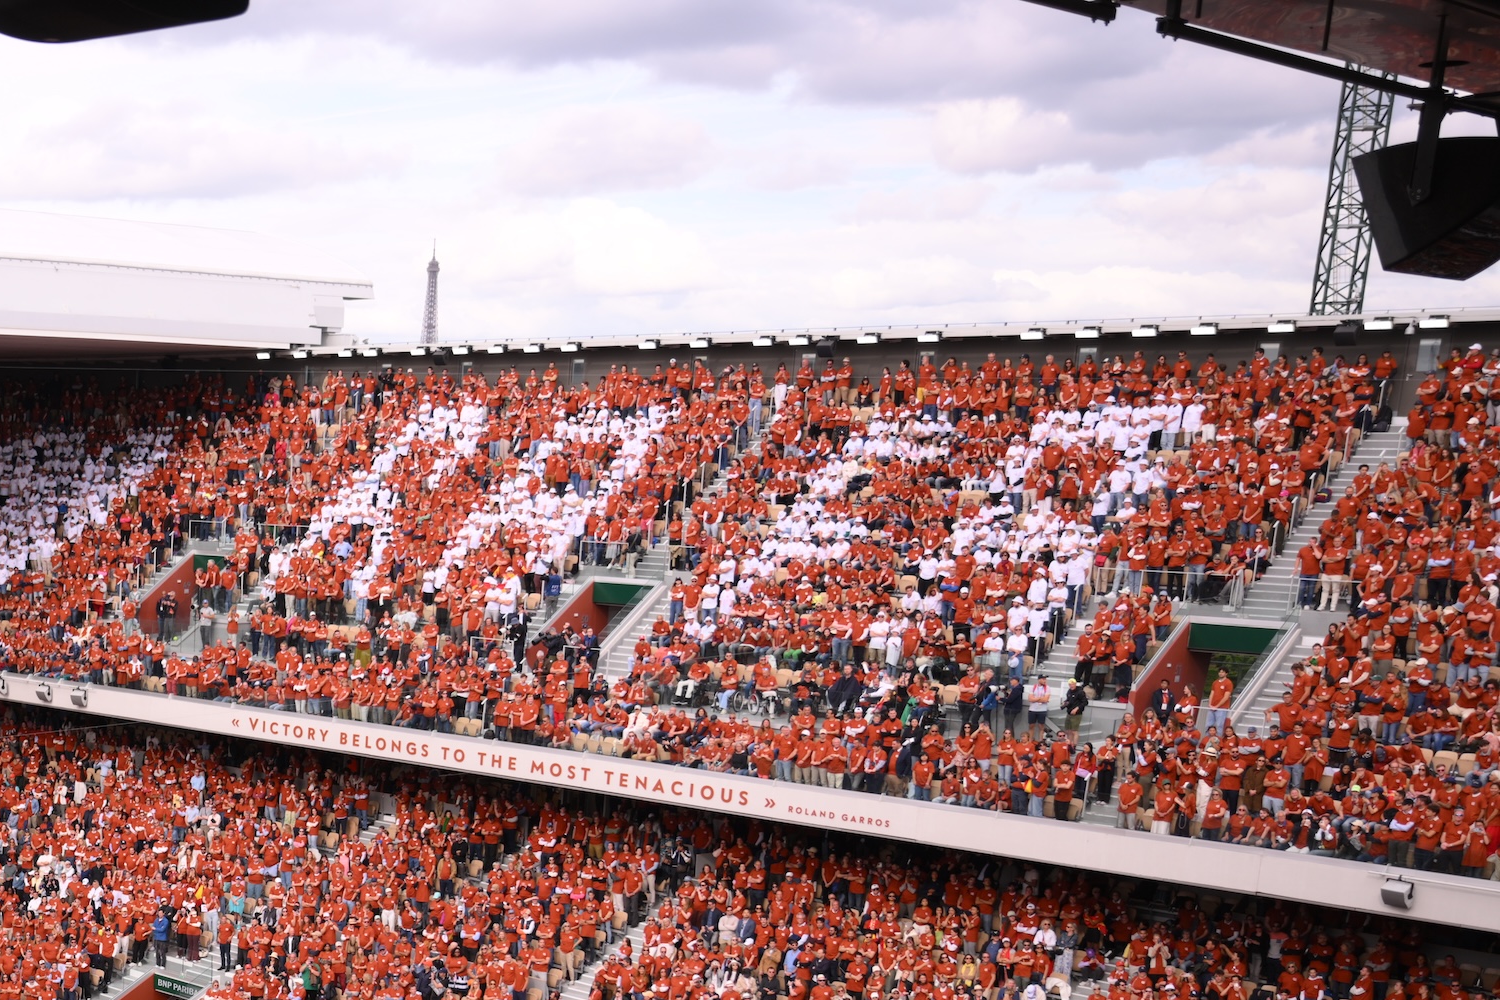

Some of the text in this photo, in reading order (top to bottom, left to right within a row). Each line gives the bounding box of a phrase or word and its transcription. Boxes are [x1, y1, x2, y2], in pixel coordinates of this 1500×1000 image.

[248, 717, 329, 743] VICTORY
[339, 732, 429, 757] BELONGS
[441, 746, 465, 763] TO
[477, 752, 517, 771] THE
[530, 760, 591, 782] MOST
[603, 770, 749, 806] TENACIOUS
[787, 805, 891, 828] ROLAND GARROS
[157, 978, 172, 989] BNP
